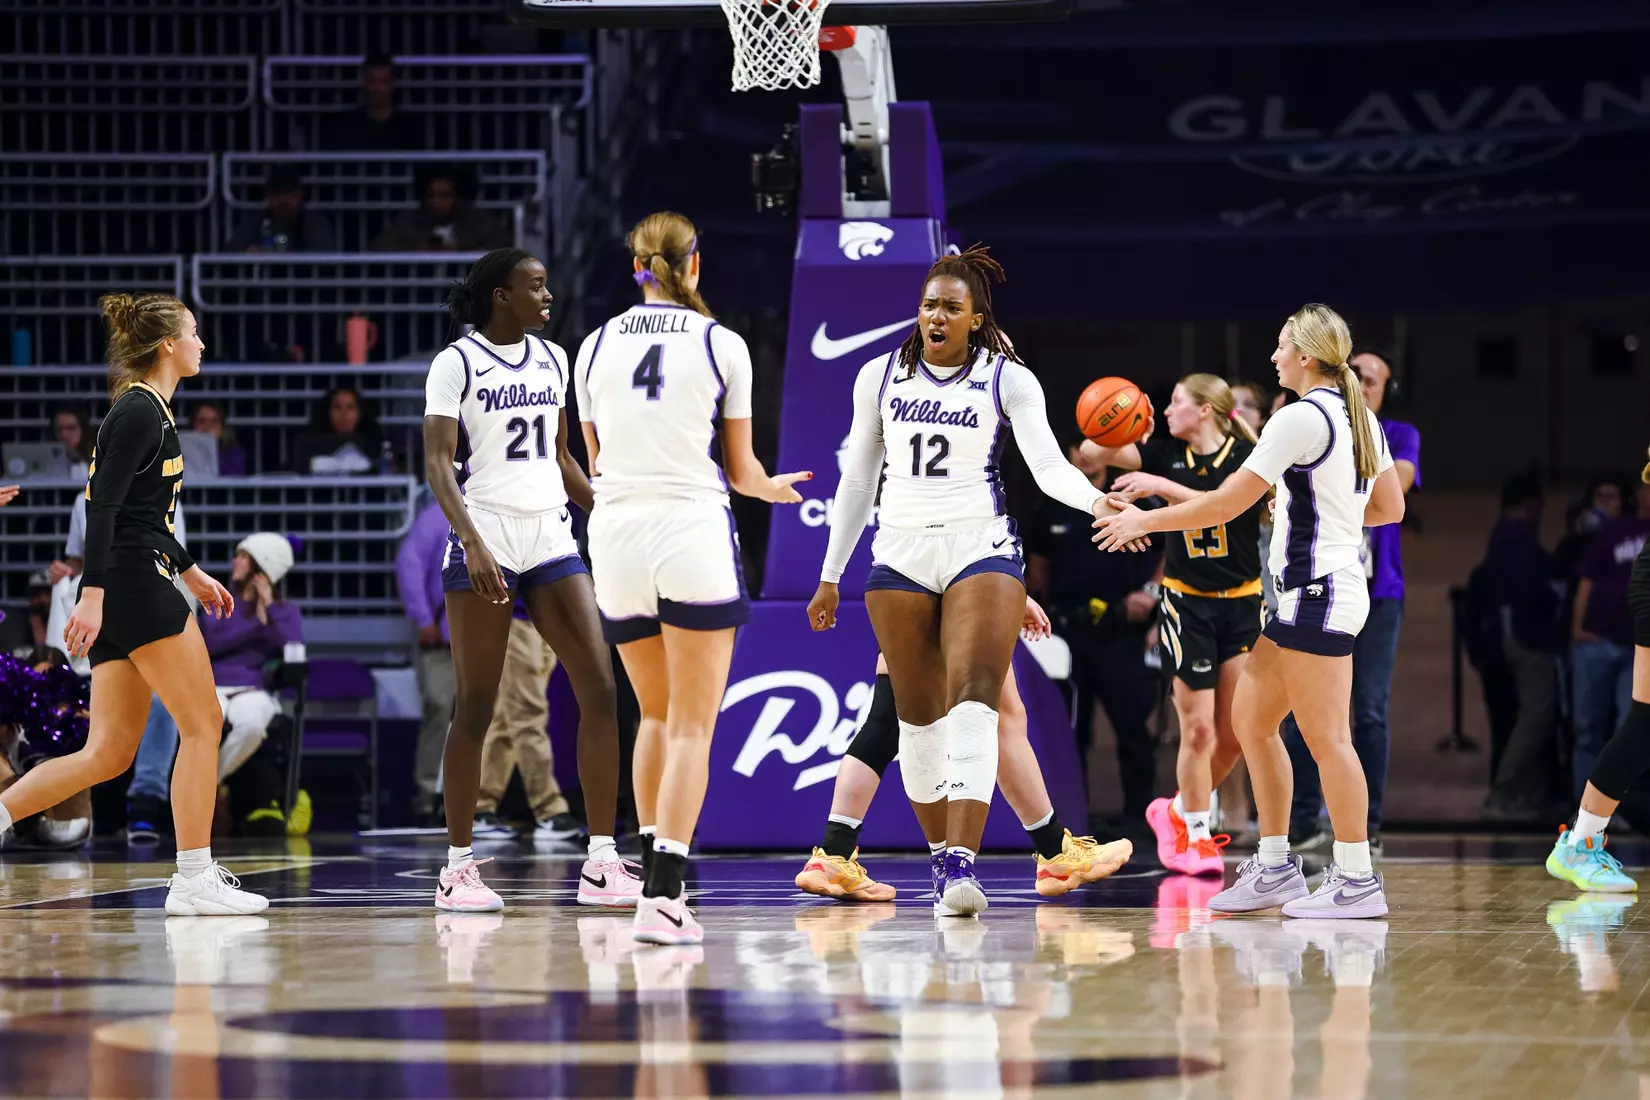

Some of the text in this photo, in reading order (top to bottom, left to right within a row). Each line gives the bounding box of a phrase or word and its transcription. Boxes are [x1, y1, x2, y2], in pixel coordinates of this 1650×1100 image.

[619, 313, 690, 335] SUNDELL
[632, 343, 665, 401] 4
[477, 383, 559, 413] Wildcats
[890, 397, 979, 429] Wildcats
[506, 414, 548, 461] 21
[910, 432, 951, 479] 12
